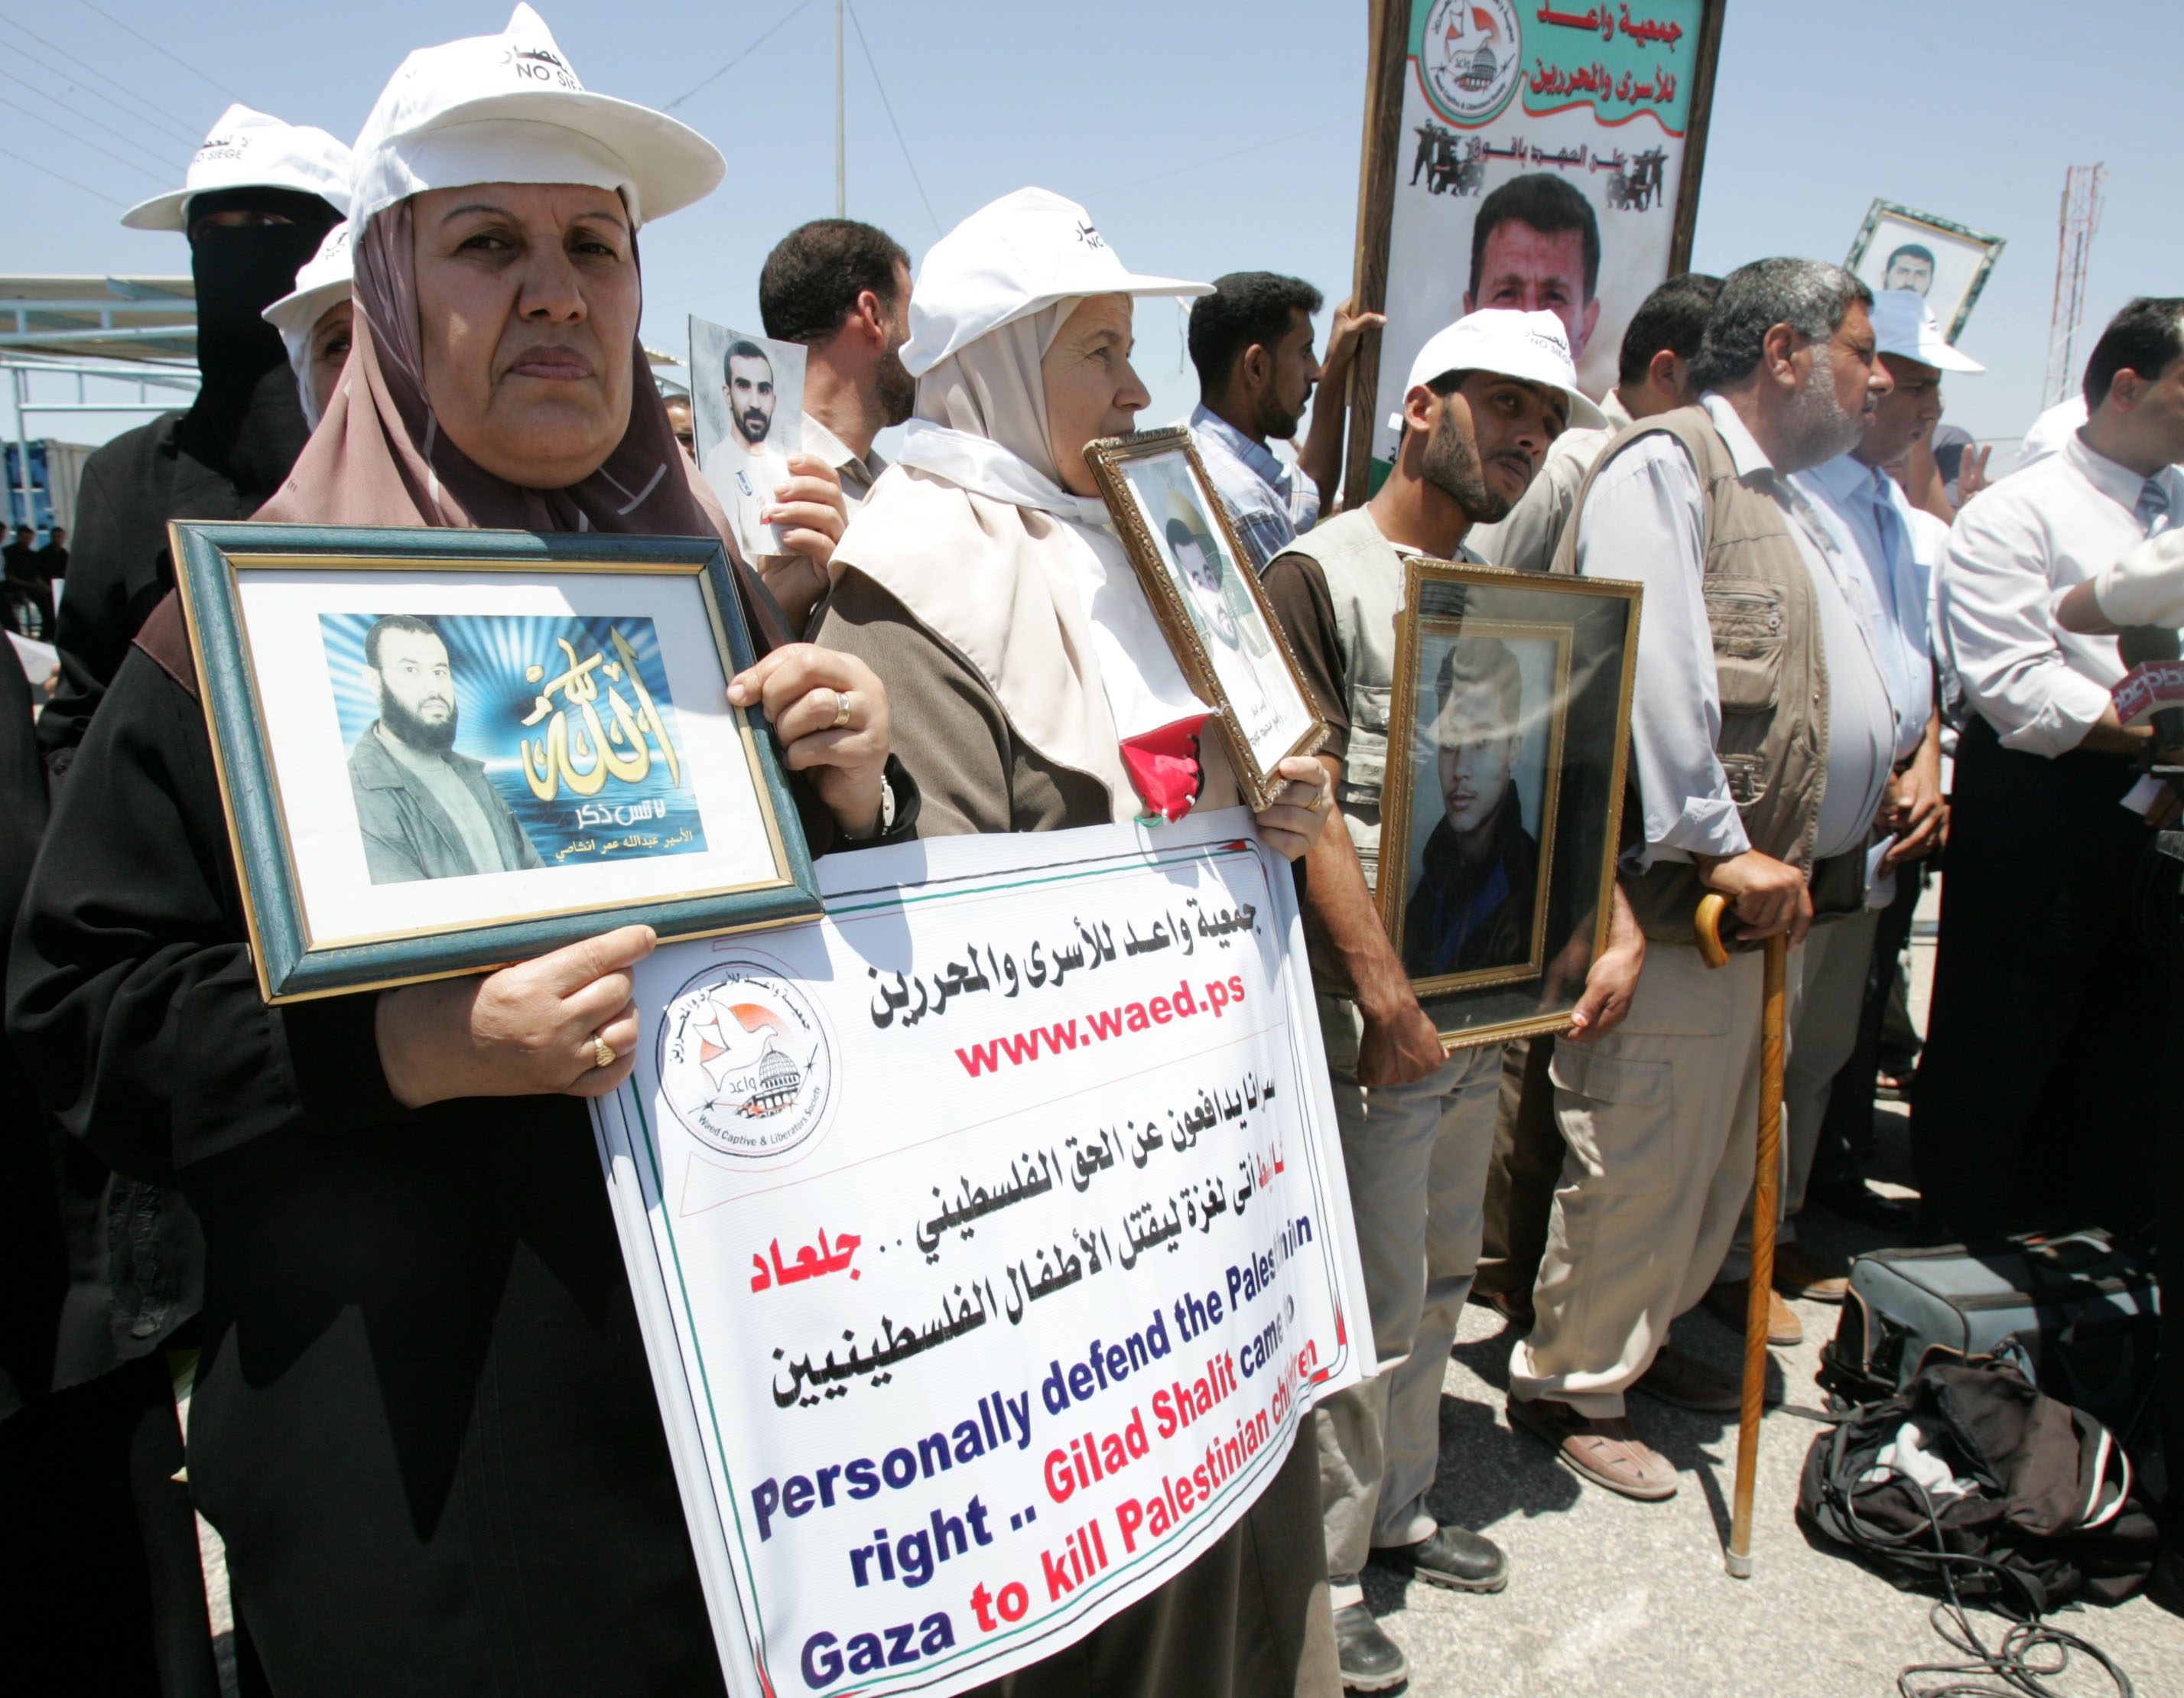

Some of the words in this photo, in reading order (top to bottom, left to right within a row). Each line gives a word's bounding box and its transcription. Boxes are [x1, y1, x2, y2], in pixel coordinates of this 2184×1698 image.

[1537, 0, 1614, 41] واعد
[1618, 3, 1682, 53] جمعية
[515, 63, 551, 81] NO
[557, 70, 583, 92] SIE
[1530, 57, 1612, 102] والمحررين
[1530, 337, 1549, 349] NO
[574, 803, 613, 831] ذكر
[622, 834, 659, 849] عبدالله
[663, 827, 694, 849] الأسير
[600, 840, 620, 855] عمر
[1023, 916, 1116, 989] للأسرى
[1123, 908, 1194, 956] واعد
[1186, 897, 1262, 949] جمعية
[867, 942, 1020, 1030] والمحررين
[954, 974, 1246, 1078] www.waed.ps
[729, 1075, 758, 1094] واعد
[1243, 1071, 1276, 1113] سرانا
[697, 1114, 720, 1137] Waed
[721, 1130, 758, 1147] Captive
[759, 1136, 768, 1146] &
[770, 1117, 807, 1144] Liberators
[804, 1085, 822, 1115] Society
[1127, 1120, 1164, 1169] عن
[1167, 1088, 1248, 1153] يدافعون
[1064, 1127, 1125, 1193] الحق
[1233, 1151, 1256, 1217] أتى
[917, 1147, 1063, 1267] الفلسطيني
[1119, 1196, 1182, 1271] ليقتل
[1179, 1175, 1227, 1234] لغزة
[750, 1227, 862, 1294] جلعاد
[1006, 1227, 1112, 1326] الأطفال
[772, 1276, 998, 1410] الفلسطينيين
[1042, 1308, 1172, 1417] defend
[1174, 1290, 1224, 1344] the
[849, 1494, 994, 1589] right
[1044, 1406, 1150, 1504] Gilad
[1152, 1348, 1237, 1439] Shalit
[1240, 1312, 1284, 1379] came
[801, 1611, 957, 1690] Gaza
[970, 1581, 1029, 1633] to
[1040, 1518, 1109, 1603] kill
[1115, 1407, 1270, 1554] Palestinian
